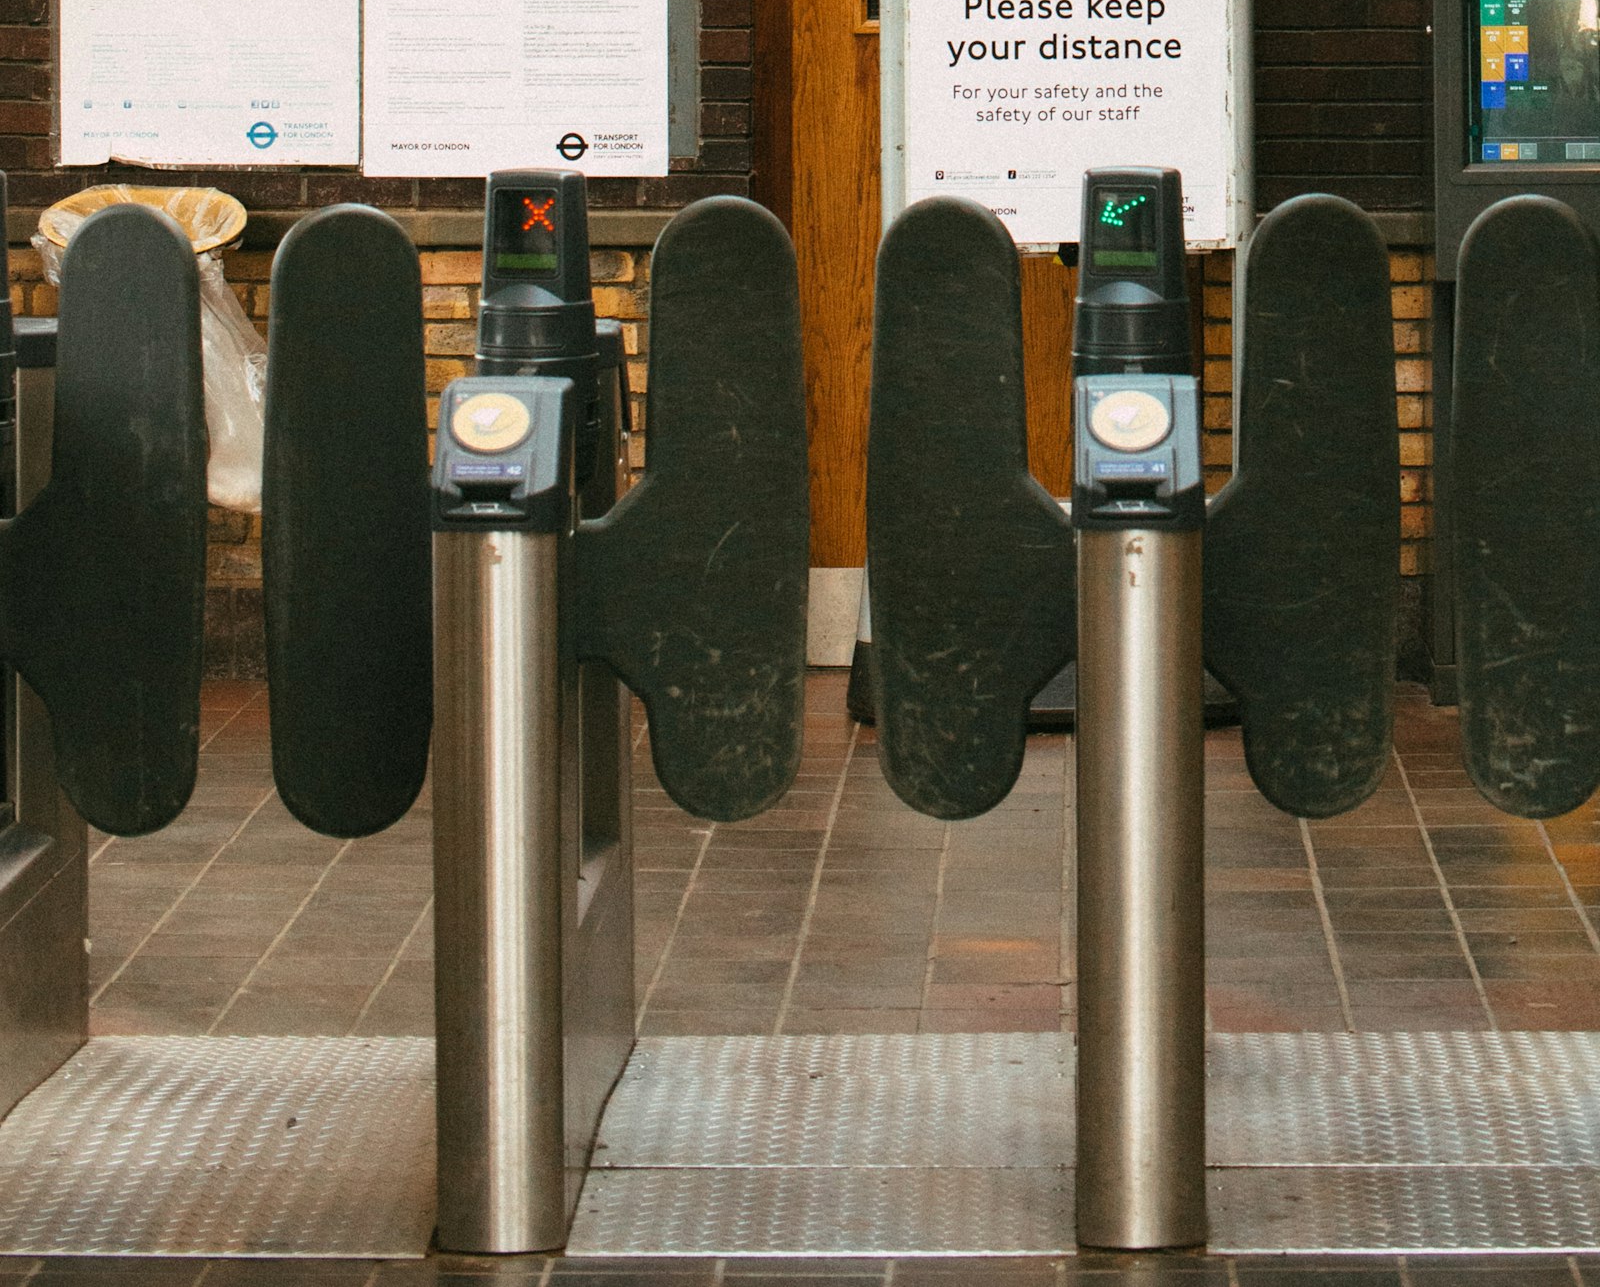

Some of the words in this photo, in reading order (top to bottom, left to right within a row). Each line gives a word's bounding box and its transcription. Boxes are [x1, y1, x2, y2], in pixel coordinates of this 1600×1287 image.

[947, 41, 1026, 67] your
[1039, 34, 1181, 59] distance
[953, 85, 981, 99] For
[987, 88, 1028, 102] your
[1035, 84, 1089, 101] safety
[1096, 84, 1127, 98] and
[1134, 84, 1162, 98] the
[977, 107, 1031, 125] safety
[1038, 107, 1056, 121] of
[1062, 110, 1092, 121] our
[1099, 106, 1139, 121] staff
[990, 207, 1017, 215] NDON
[506, 465, 522, 475] 42
[1152, 463, 1165, 472] 41
